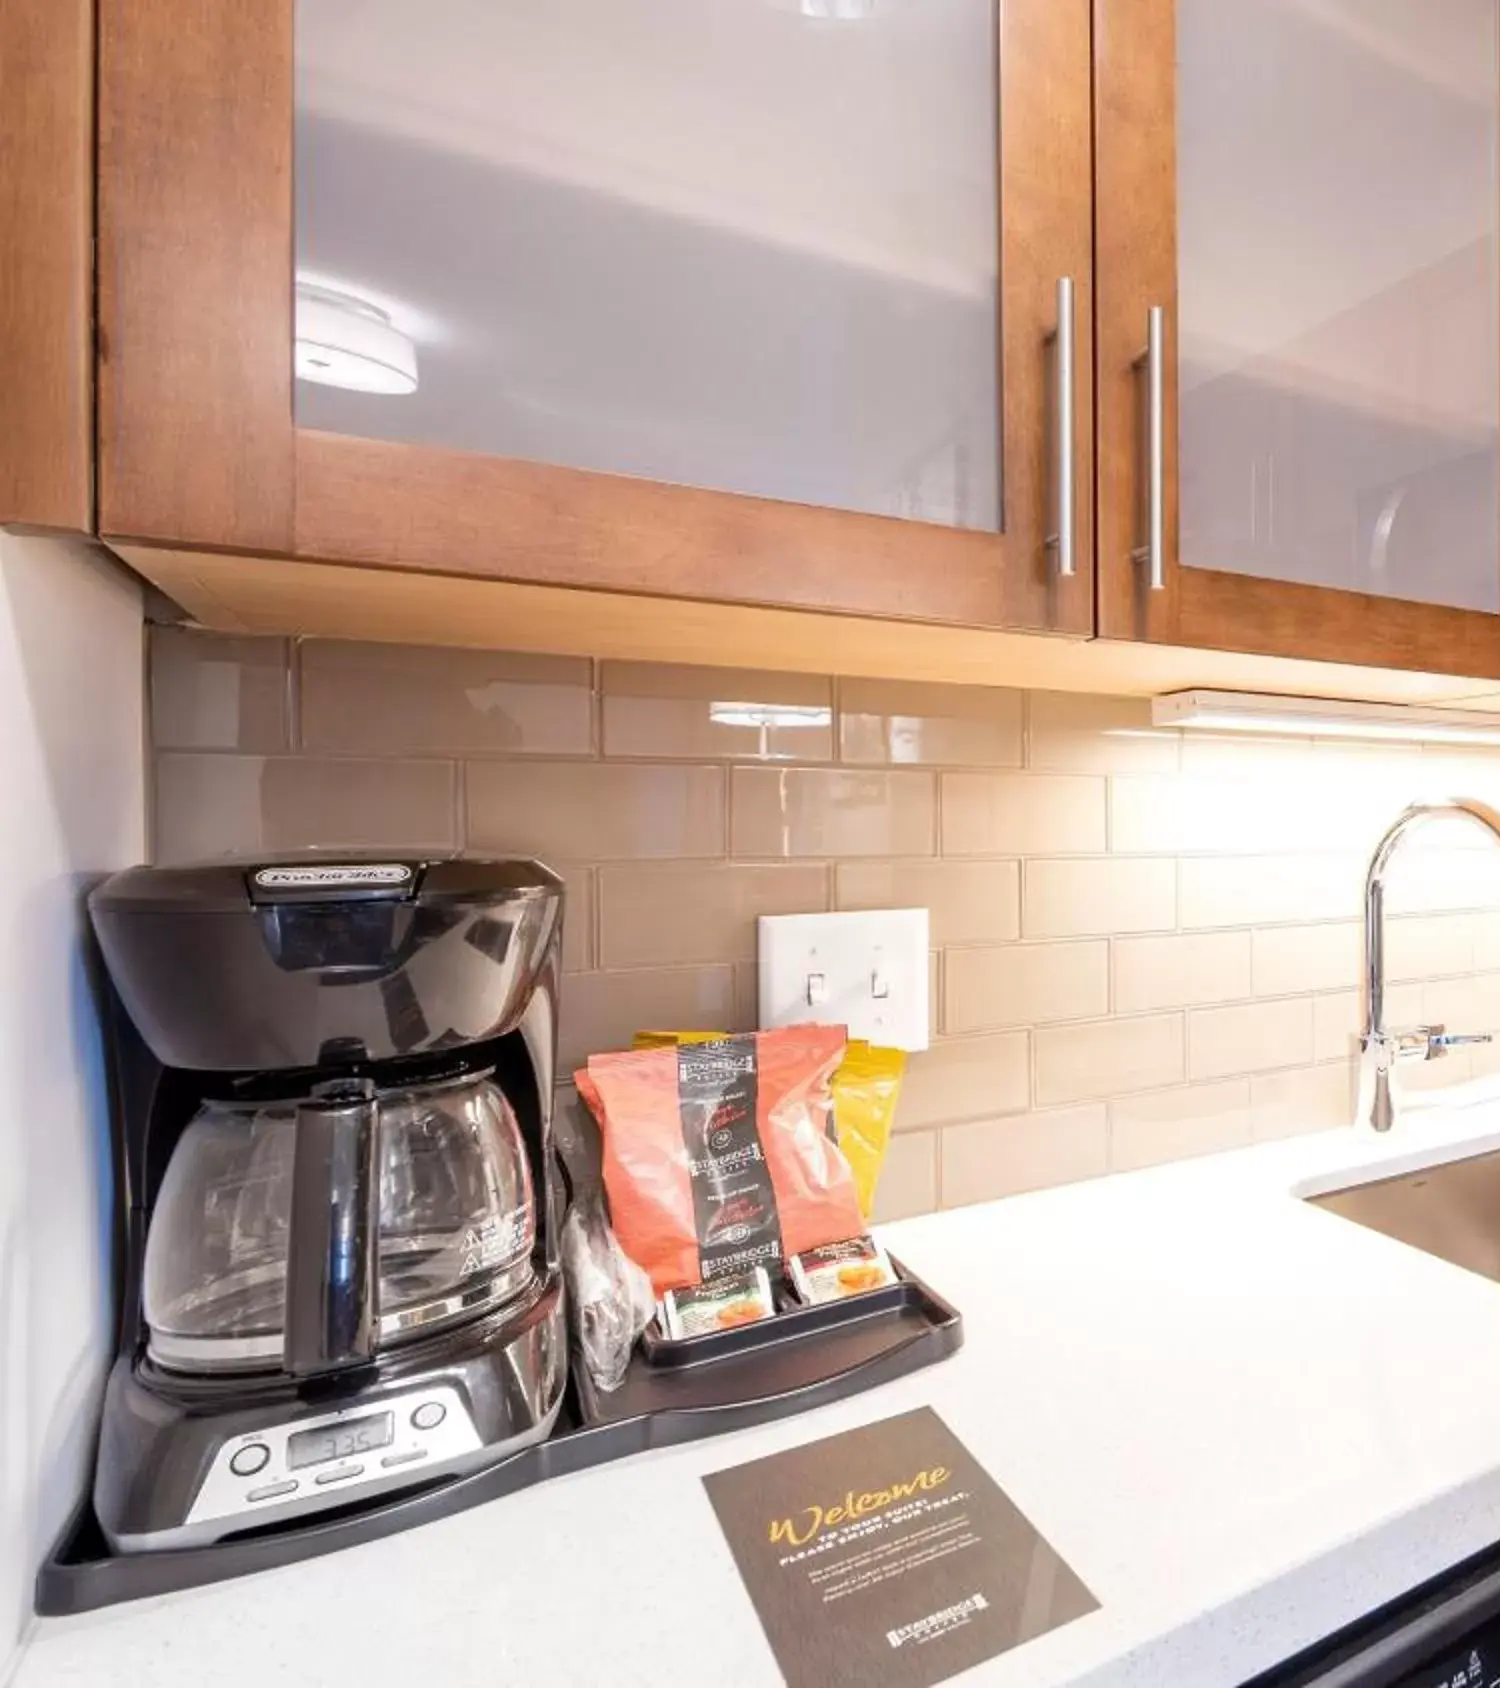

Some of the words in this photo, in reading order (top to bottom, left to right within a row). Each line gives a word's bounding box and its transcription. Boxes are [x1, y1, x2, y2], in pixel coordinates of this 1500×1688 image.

[769, 1466, 953, 1546] Welcome
[818, 1530, 839, 1543] TO
[842, 1515, 881, 1534] YOUR
[779, 1541, 835, 1567] PLEASE
[891, 1509, 923, 1525] OUR
